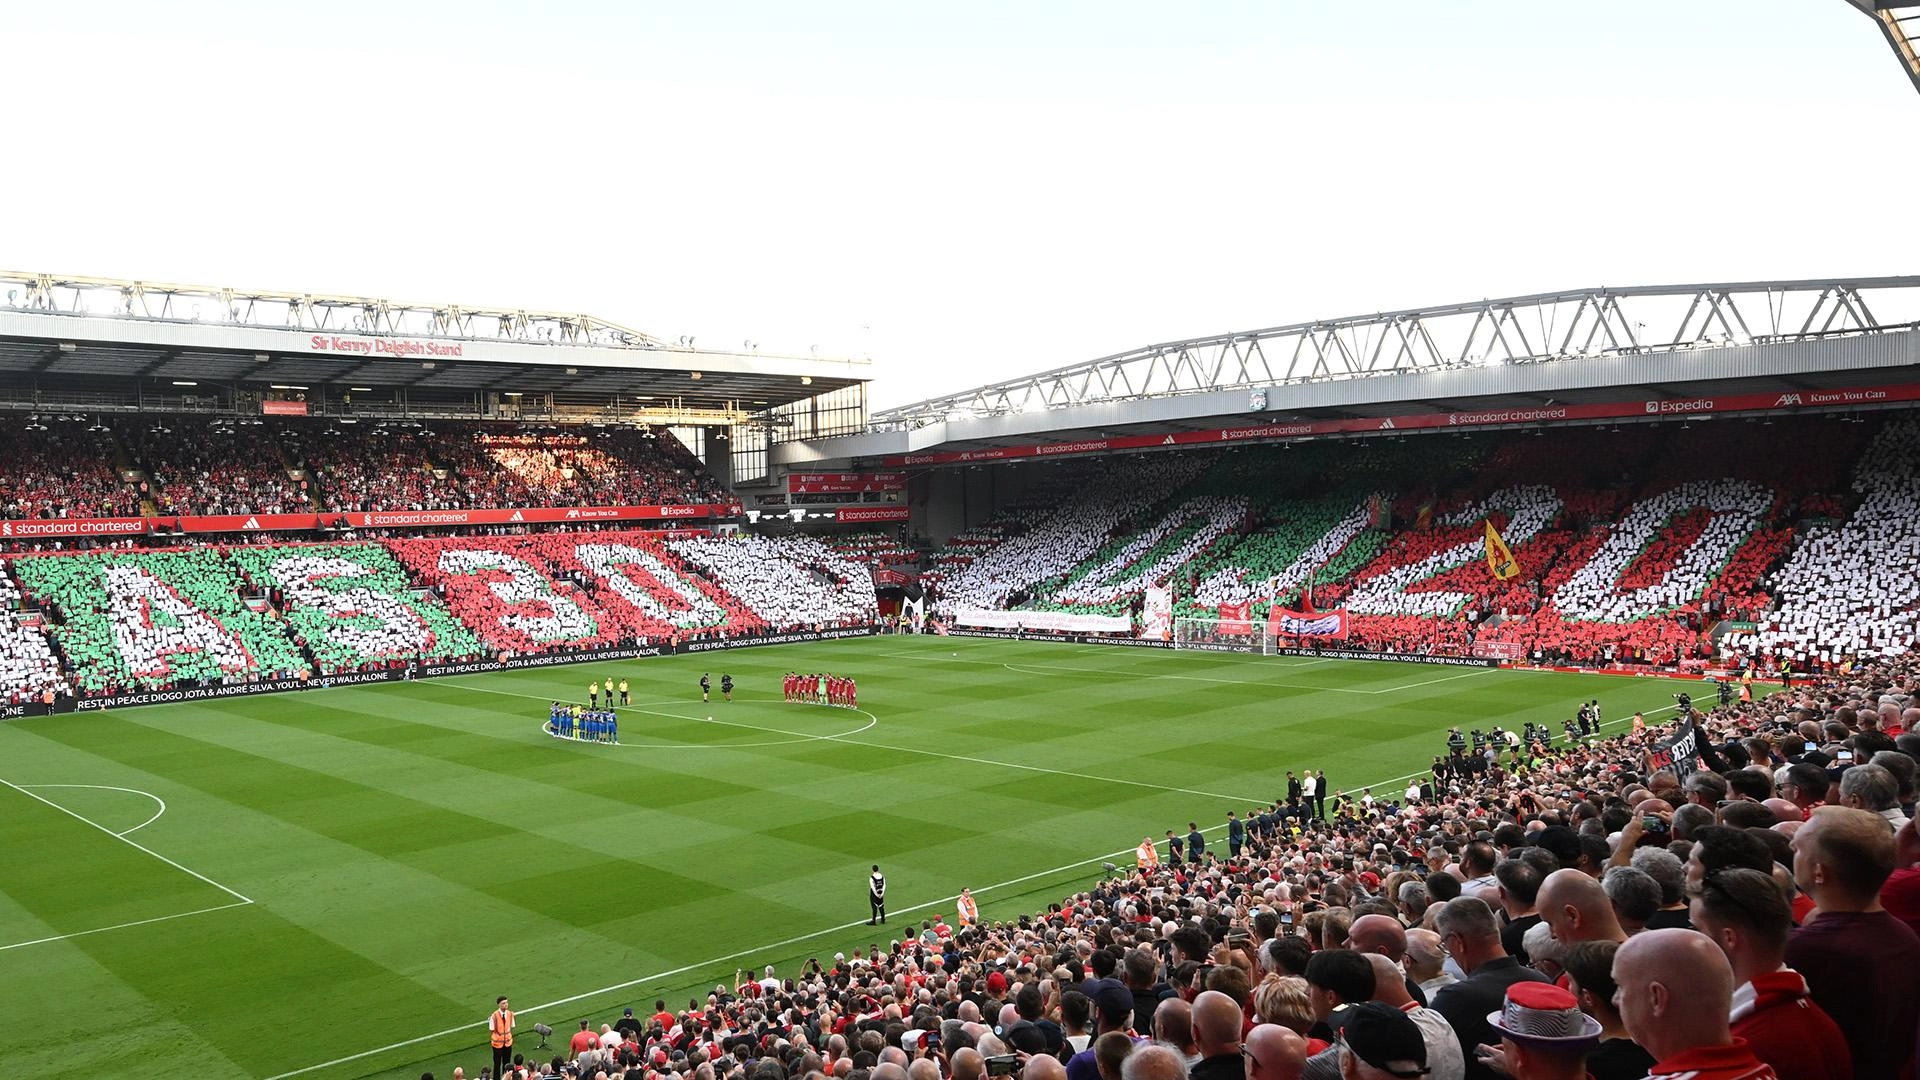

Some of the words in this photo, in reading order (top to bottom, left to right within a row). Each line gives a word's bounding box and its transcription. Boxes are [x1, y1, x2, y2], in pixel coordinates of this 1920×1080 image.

[312, 336, 329, 350] Sir
[332, 337, 373, 354] Kenny
[375, 339, 425, 358] Dalglish
[426, 342, 462, 356] Stand
[1775, 394, 1802, 406] AXA
[1811, 394, 1841, 402] Know
[1843, 392, 1862, 400] You
[1865, 390, 1886, 398] Can
[1661, 399, 1713, 412] Expedia
[1460, 412, 1508, 423] standard
[1511, 408, 1566, 420] chartered
[1230, 429, 1268, 438] standard
[1269, 424, 1311, 435] chartered
[1042, 445, 1072, 454] standard
[1074, 441, 1107, 450] chartered
[912, 456, 934, 464] Expedia
[566, 510, 580, 518] AXA
[668, 507, 694, 516] Expedia
[846, 510, 876, 519] standard
[877, 510, 908, 518] chartered
[374, 514, 420, 524] standard
[422, 513, 468, 522] chartered
[16, 522, 77, 534] standard
[80, 520, 142, 532] chartered
[853, 628, 870, 636] ALONE
[426, 667, 445, 675] REST
[456, 664, 479, 672] PEACE
[505, 660, 523, 668] JOTA
[530, 656, 553, 666] ANDRÉ
[598, 651, 619, 659] NEVER
[640, 648, 660, 656] ALONE
[78, 699, 102, 709] REST
[104, 698, 115, 707] IN
[118, 695, 149, 706] PEACE
[150, 691, 183, 703] DIOGO
[183, 689, 206, 699] JOTA
[216, 684, 248, 696] ANDRÉ
[249, 684, 274, 693] SILVA.
[276, 680, 306, 690] YOU'L
[307, 678, 336, 687] NEVER
[336, 675, 360, 684] WALK
[361, 672, 388, 682] ALONE
